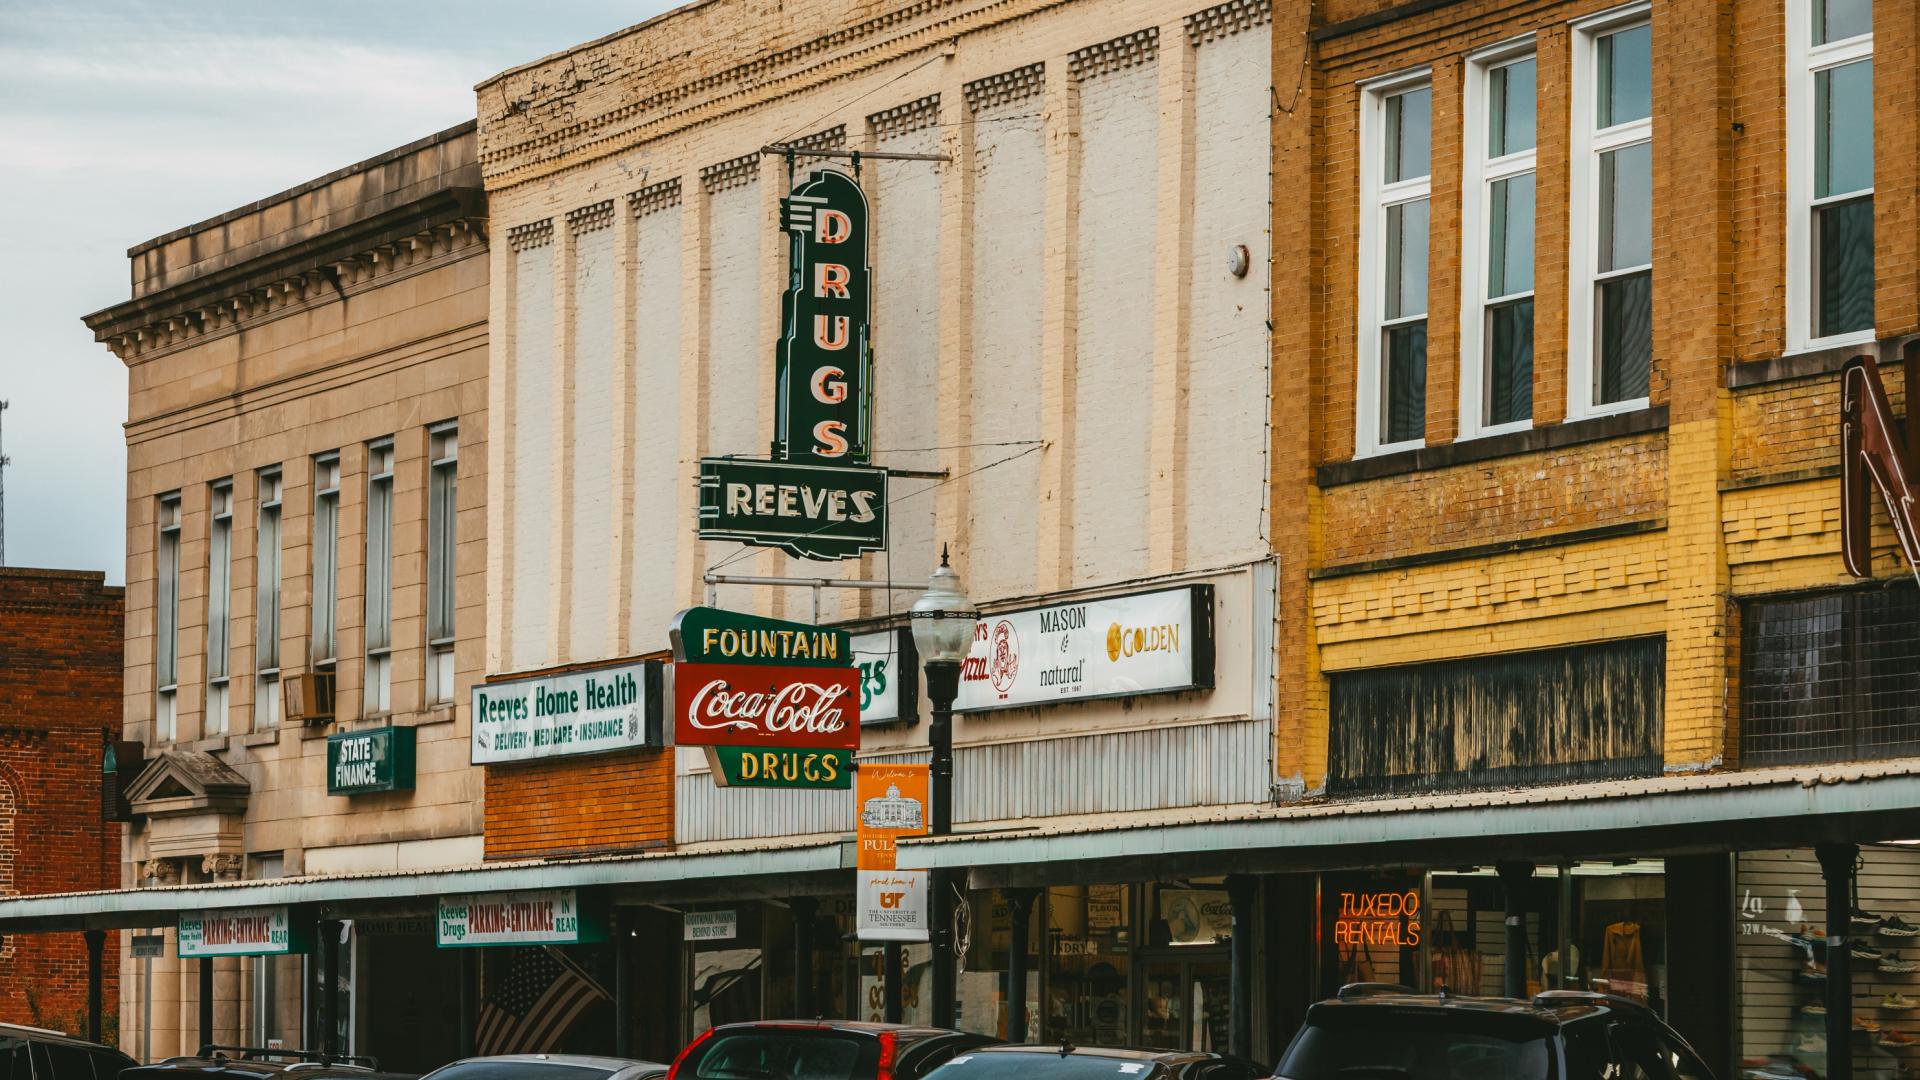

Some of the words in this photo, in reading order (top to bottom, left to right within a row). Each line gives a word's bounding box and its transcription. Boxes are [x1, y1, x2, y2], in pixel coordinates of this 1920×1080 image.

[810, 208, 852, 458] DRUGS
[726, 482, 878, 524] REEVES
[1040, 606, 1086, 633] MASON
[703, 628, 837, 660] FOUNTAIN
[1122, 623, 1180, 657] GOLDEN
[479, 693, 528, 723] Reeves
[535, 686, 579, 717] Home
[586, 672, 637, 710] Health
[689, 679, 850, 733] Coca-Cola
[494, 731, 528, 751] DELIVERY
[534, 725, 573, 746] MEDICARE
[579, 718, 623, 741] INSURANCE
[341, 737, 371, 763] STATE
[335, 762, 376, 787] FINANCE
[741, 752, 839, 782] DRUGS
[440, 902, 467, 920] Reeves
[469, 903, 506, 934] PARKING
[511, 901, 554, 932] ENTRANCE
[561, 898, 570, 914] IN
[868, 913, 917, 923] TENNESSEE
[1341, 892, 1418, 917] TUXEDO
[180, 918, 202, 931] Reeves
[202, 917, 232, 945] PARKING
[236, 916, 270, 944] ENTRANCE
[276, 914, 283, 927] IN
[271, 930, 288, 944] REAR
[443, 921, 466, 940] Drugs
[556, 917, 577, 933] REAR
[1335, 921, 1420, 946] RENTALS
